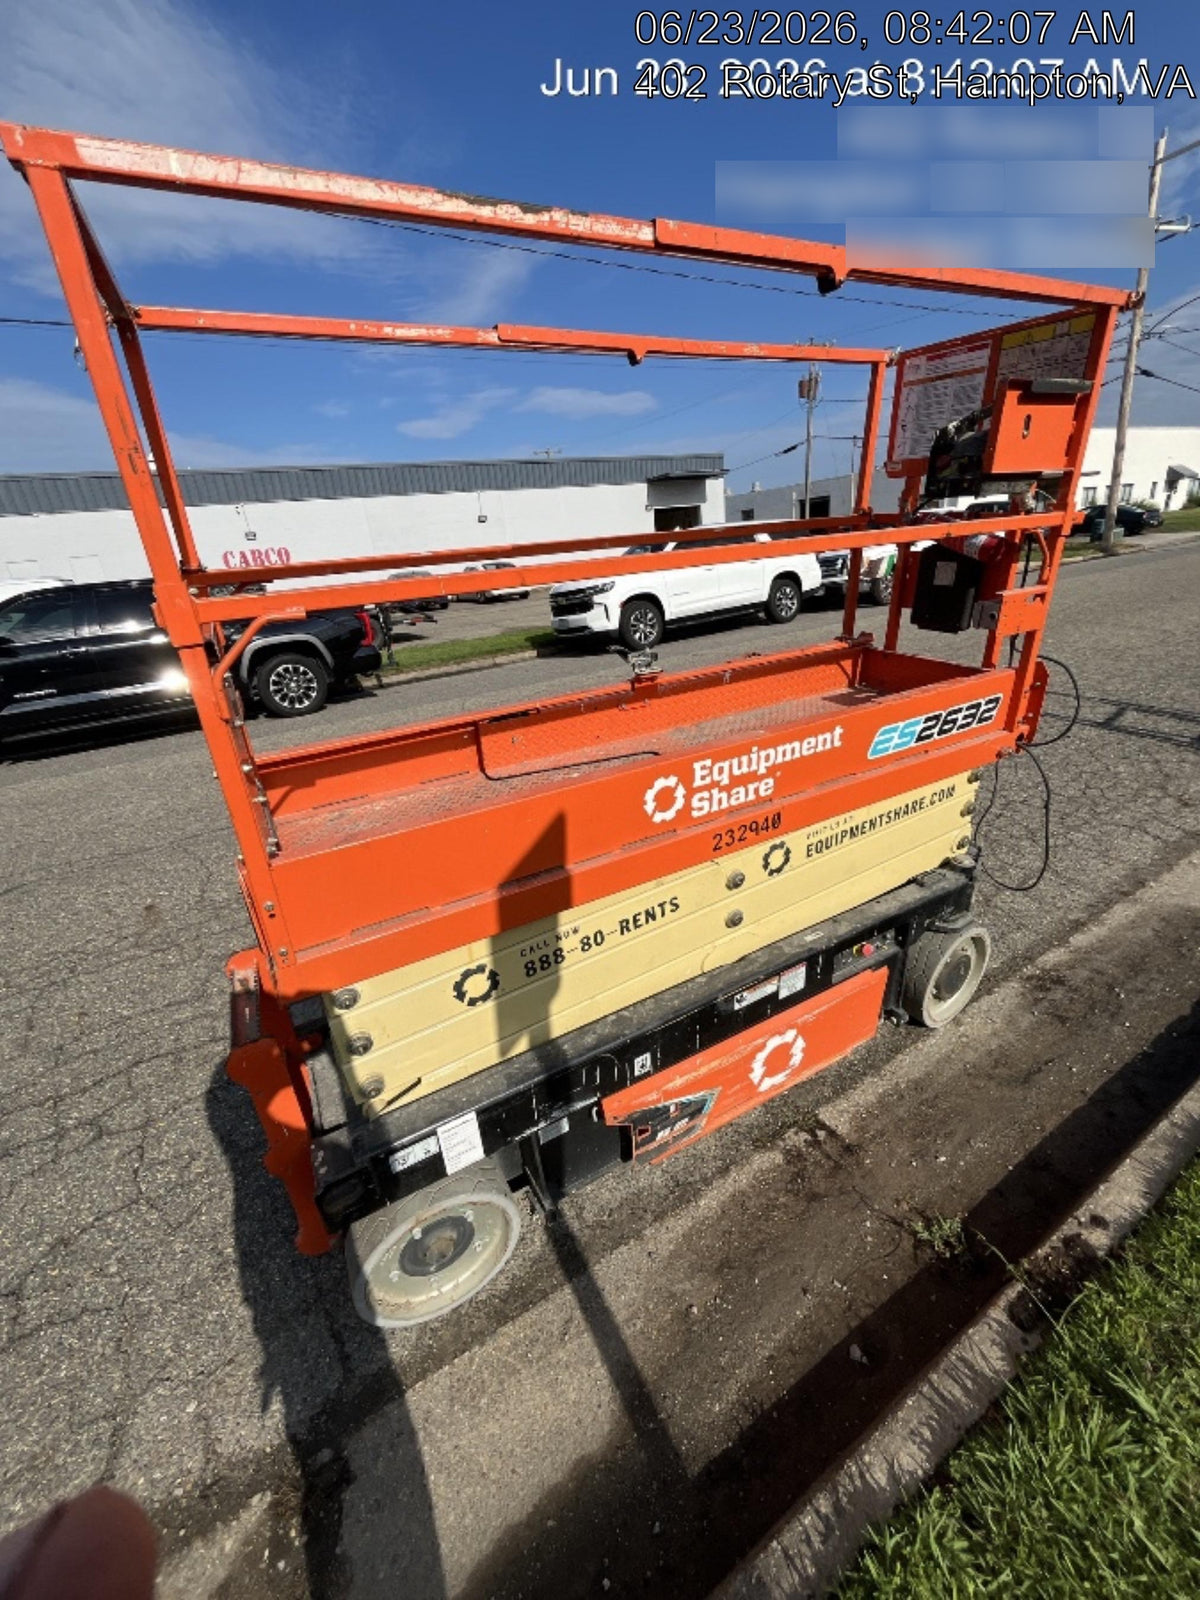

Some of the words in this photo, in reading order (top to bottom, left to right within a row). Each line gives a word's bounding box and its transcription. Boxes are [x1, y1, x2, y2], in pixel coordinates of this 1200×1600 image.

[868, 694, 1003, 759] ES2632
[692, 725, 843, 788] Equipment
[691, 776, 775, 818] Share
[806, 784, 956, 858] EQUIPMENTSHARE.COM
[712, 811, 783, 852] 232940
[520, 939, 550, 958] CALL
[555, 924, 581, 943] NOW
